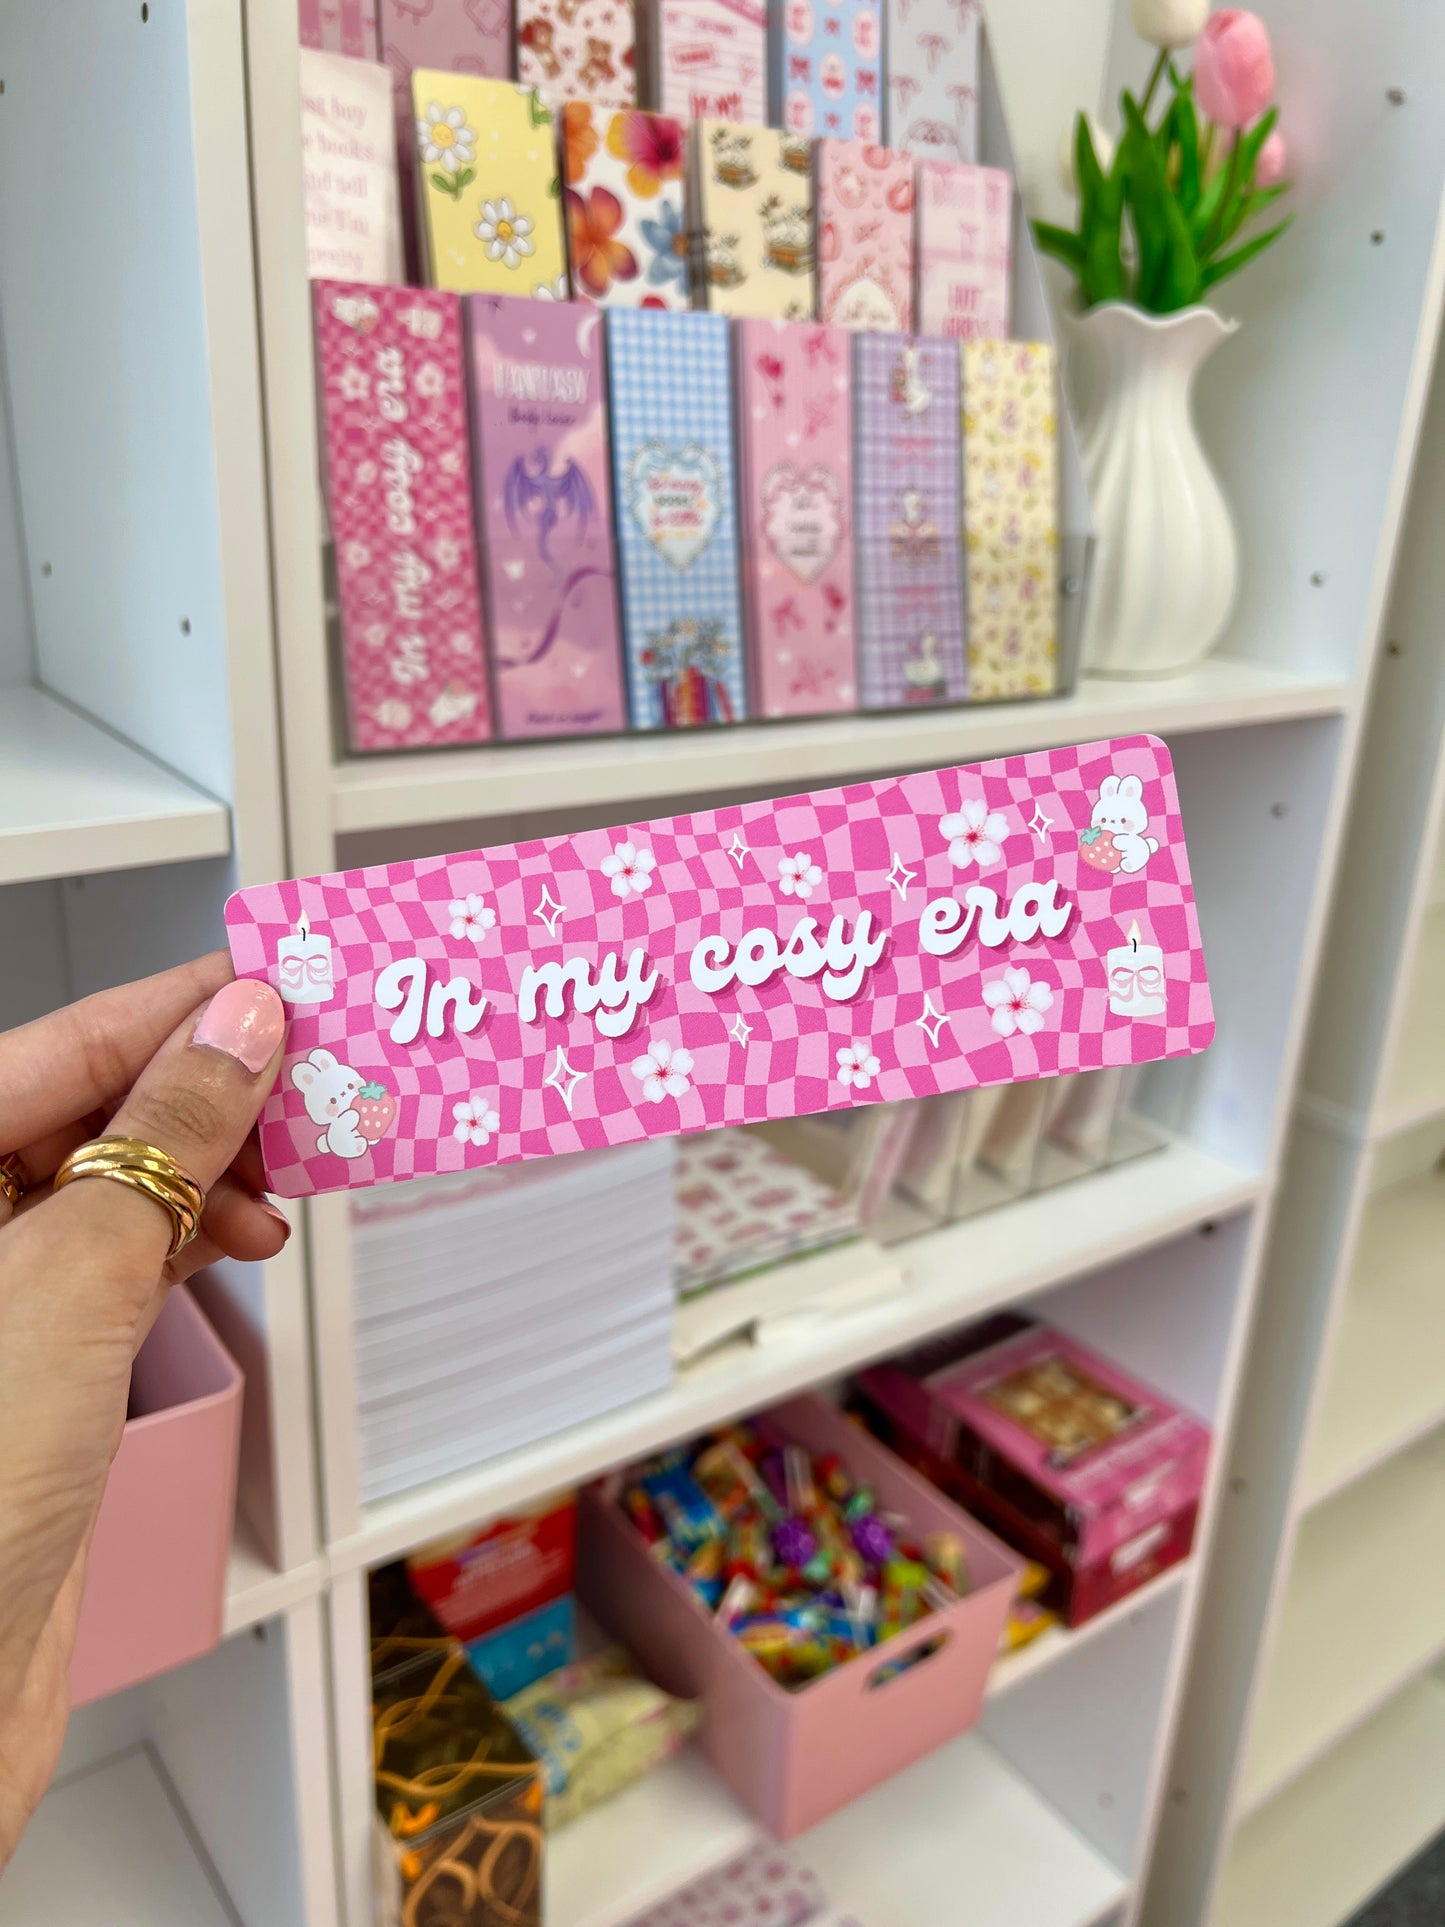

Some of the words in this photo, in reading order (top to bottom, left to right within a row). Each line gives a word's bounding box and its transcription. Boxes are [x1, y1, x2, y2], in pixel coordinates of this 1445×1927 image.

[376, 346, 406, 423] era
[380, 437, 424, 535] cosy
[375, 956, 488, 1044] In
[517, 946, 660, 1037] my
[689, 910, 889, 1001] cosy
[918, 878, 1073, 956] era
